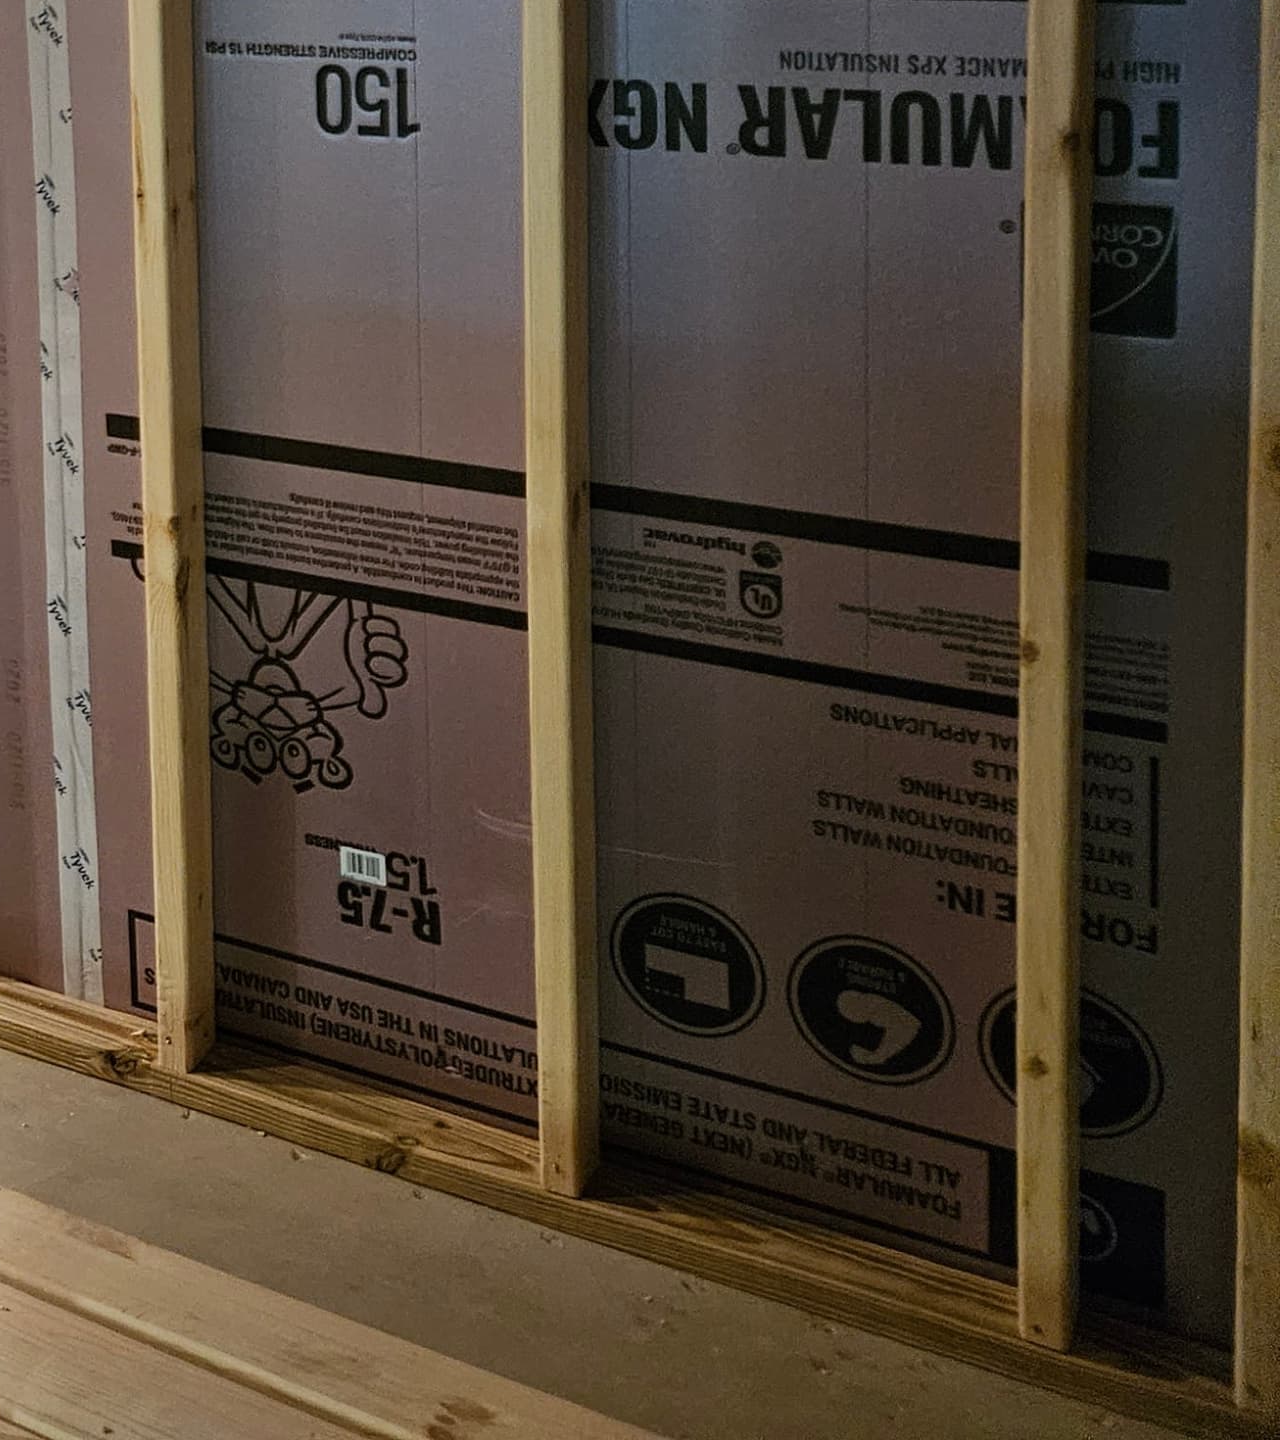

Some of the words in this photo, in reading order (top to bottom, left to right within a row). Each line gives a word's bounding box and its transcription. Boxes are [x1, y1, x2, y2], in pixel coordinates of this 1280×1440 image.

[315, 63, 421, 139] 150
[738, 85, 1180, 178] FOMULAR
[338, 881, 441, 946] R-7.5
